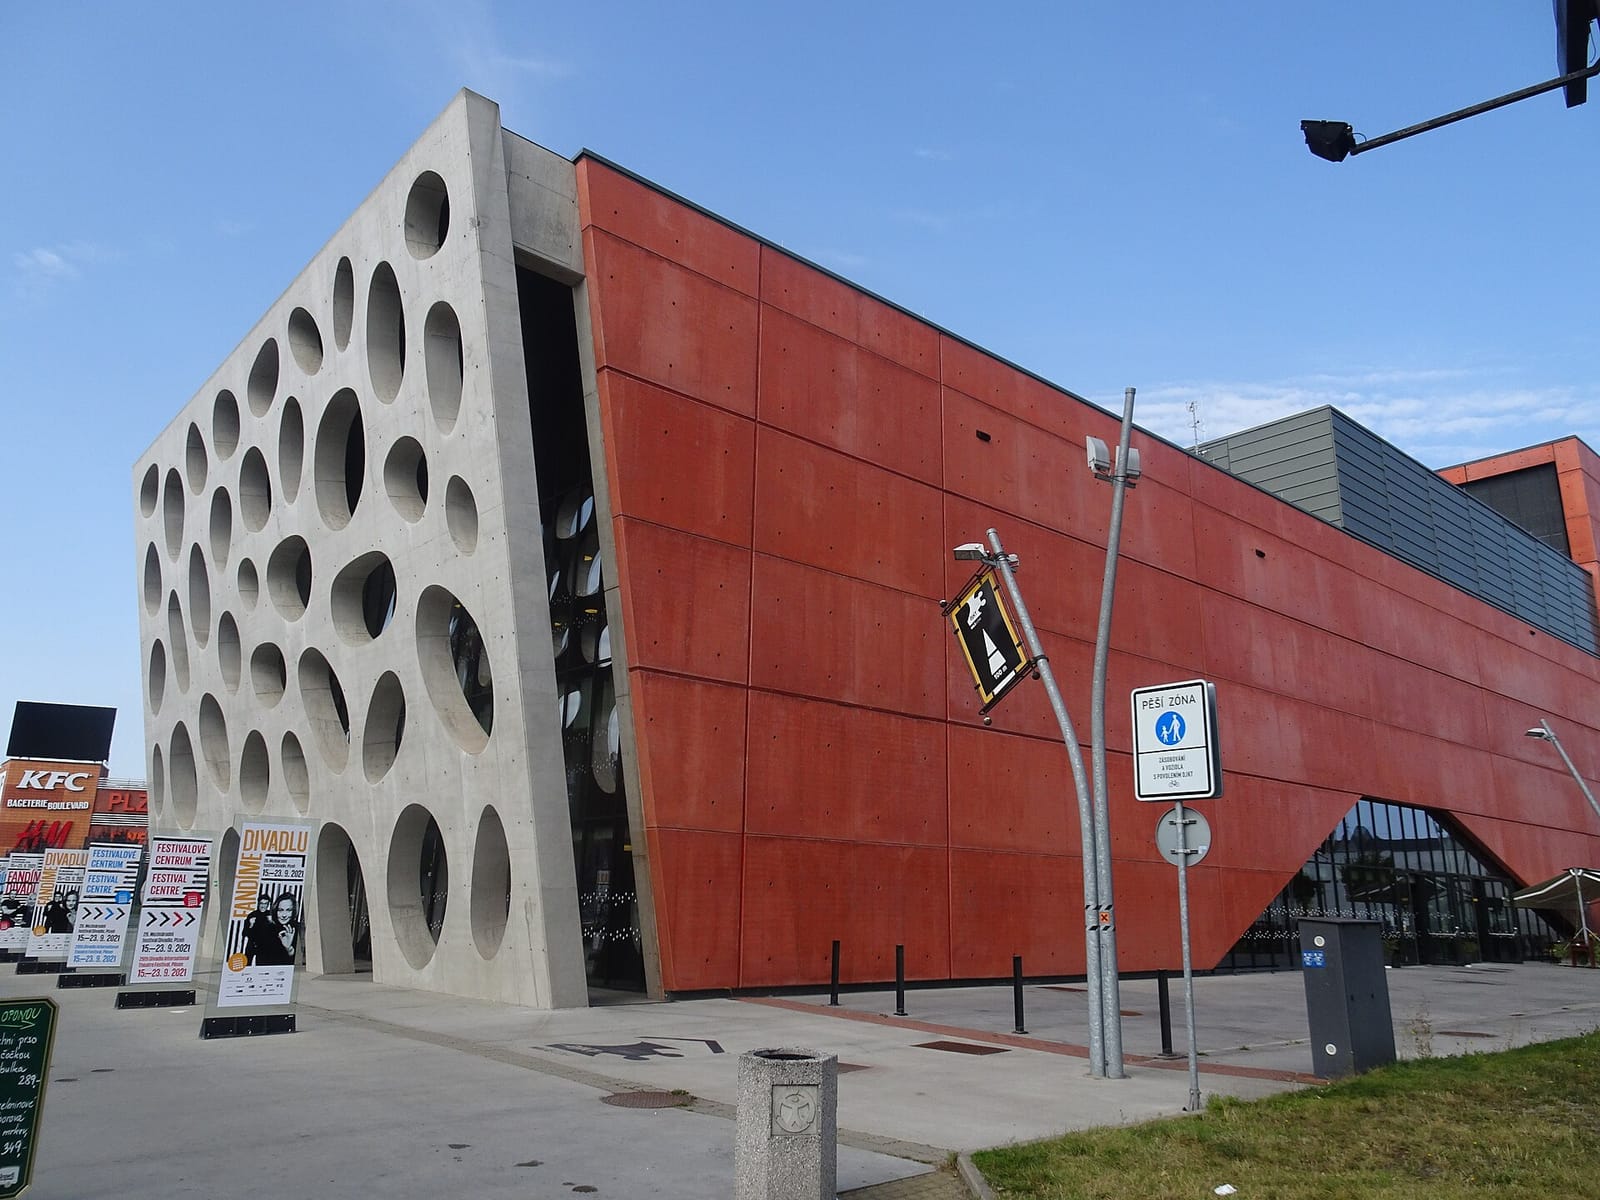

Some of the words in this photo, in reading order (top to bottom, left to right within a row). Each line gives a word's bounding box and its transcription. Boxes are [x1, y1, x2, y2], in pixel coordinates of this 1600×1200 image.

[1142, 696, 1164, 710] PĚŠÍ
[1168, 694, 1196, 707] ZÓNA
[16, 770, 89, 792] KFC
[7, 798, 48, 808] BAGETERIE
[48, 801, 89, 810] BOULEVARD
[108, 791, 147, 812] PLZ
[243, 829, 308, 852] DIVADLU
[92, 849, 137, 859] FESTIVALOVÉ
[157, 843, 207, 854] FESTIVALOVÉ
[91, 860, 123, 868] CENTRUM
[155, 855, 192, 866] CENTRUM
[7, 868, 41, 882] FANDÍM
[88, 875, 118, 884] FESTIVAL
[152, 873, 188, 883] FESTIVAL
[291, 870, 304, 879] 2021
[86, 886, 112, 894] CENTRE
[150, 885, 180, 895] CENTRE
[233, 853, 262, 918] FANDÍME
[175, 944, 191, 953] 2021
[171, 968, 187, 977] 2021
[0, 1060, 27, 1073] bulka
